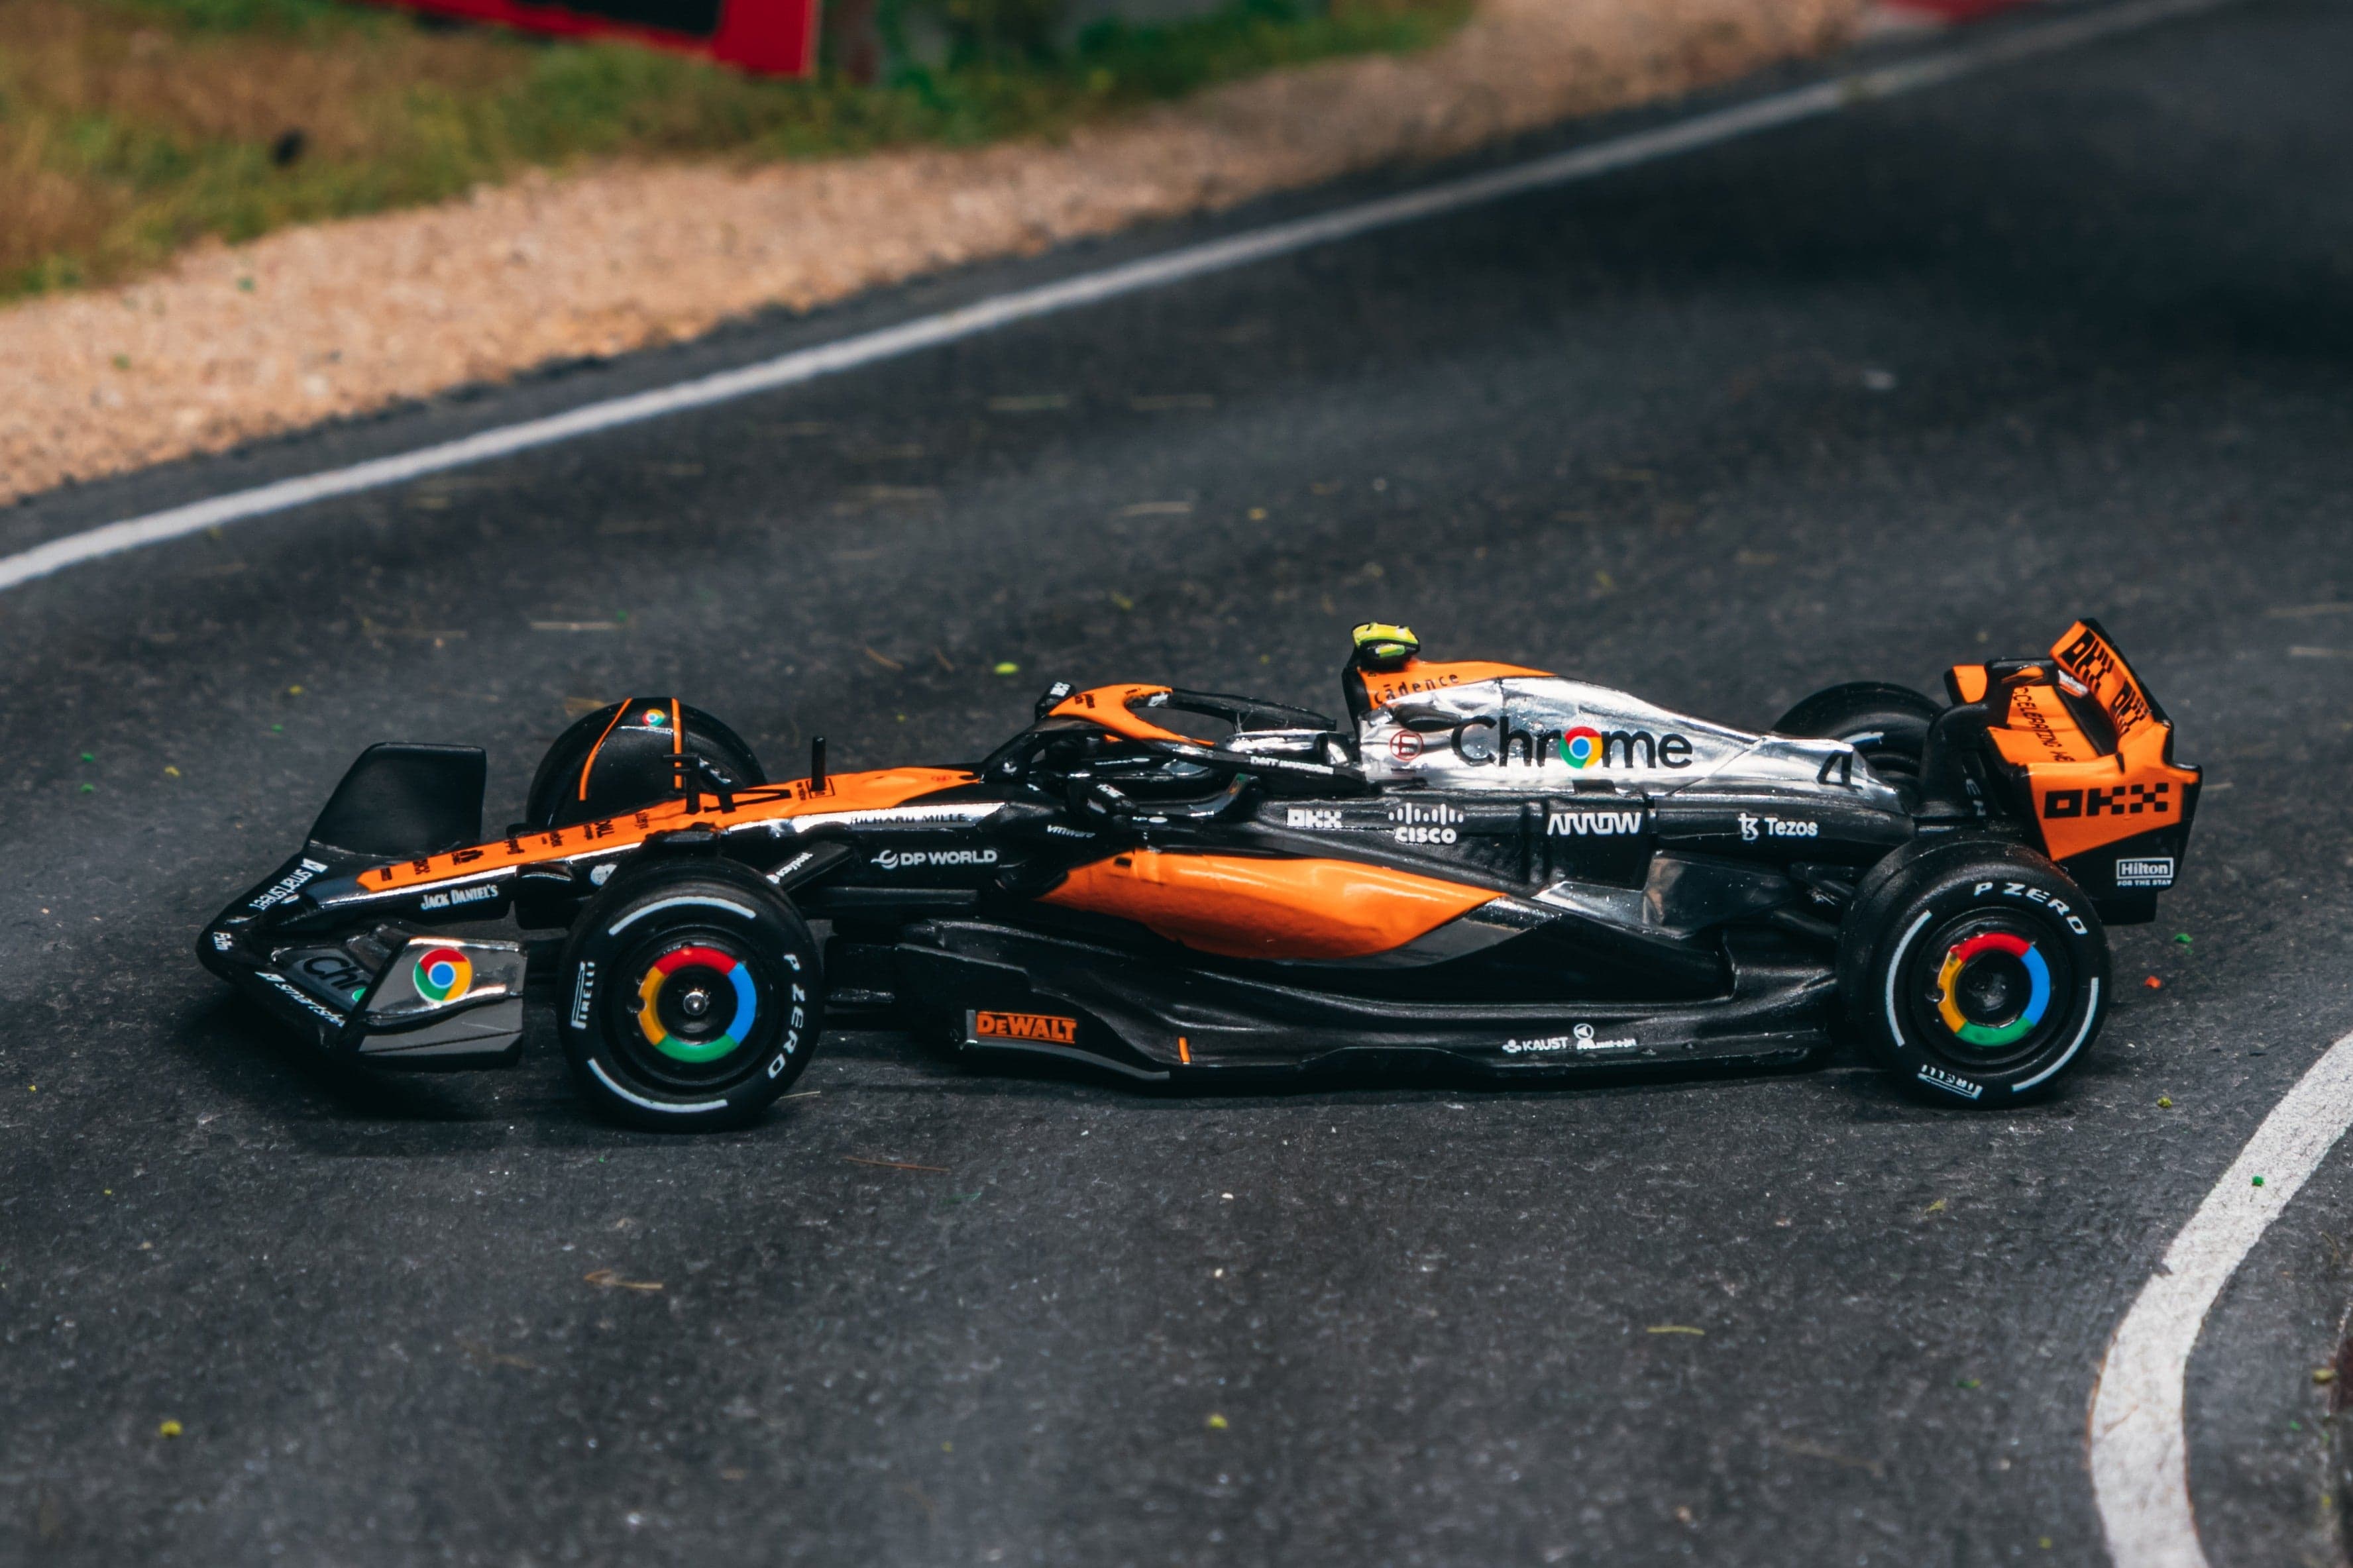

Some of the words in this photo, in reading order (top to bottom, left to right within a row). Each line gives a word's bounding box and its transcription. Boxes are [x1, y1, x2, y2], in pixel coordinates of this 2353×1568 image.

[1450, 715, 1694, 770] Chrome
[1816, 749, 1863, 794] 4
[2044, 782, 2169, 819] OKX
[1287, 809, 1342, 829] OKX
[1547, 812, 1642, 836] ARROW
[1763, 817, 1819, 837] Tezos
[900, 853, 926, 866] DP
[929, 850, 998, 865] WORLD
[2121, 862, 2169, 875] Hilton
[421, 894, 450, 910] JACK
[451, 884, 498, 904] DANIEL'S
[1973, 882, 1993, 897] P
[2002, 882, 2088, 935] ZERO
[783, 953, 800, 971] P
[303, 956, 368, 1002] Chr
[571, 961, 595, 1029] PIRELLI
[767, 983, 806, 1079] ZERO
[1523, 1037, 1568, 1051] KAUST
[1917, 1064, 1983, 1100] PIRELLI
